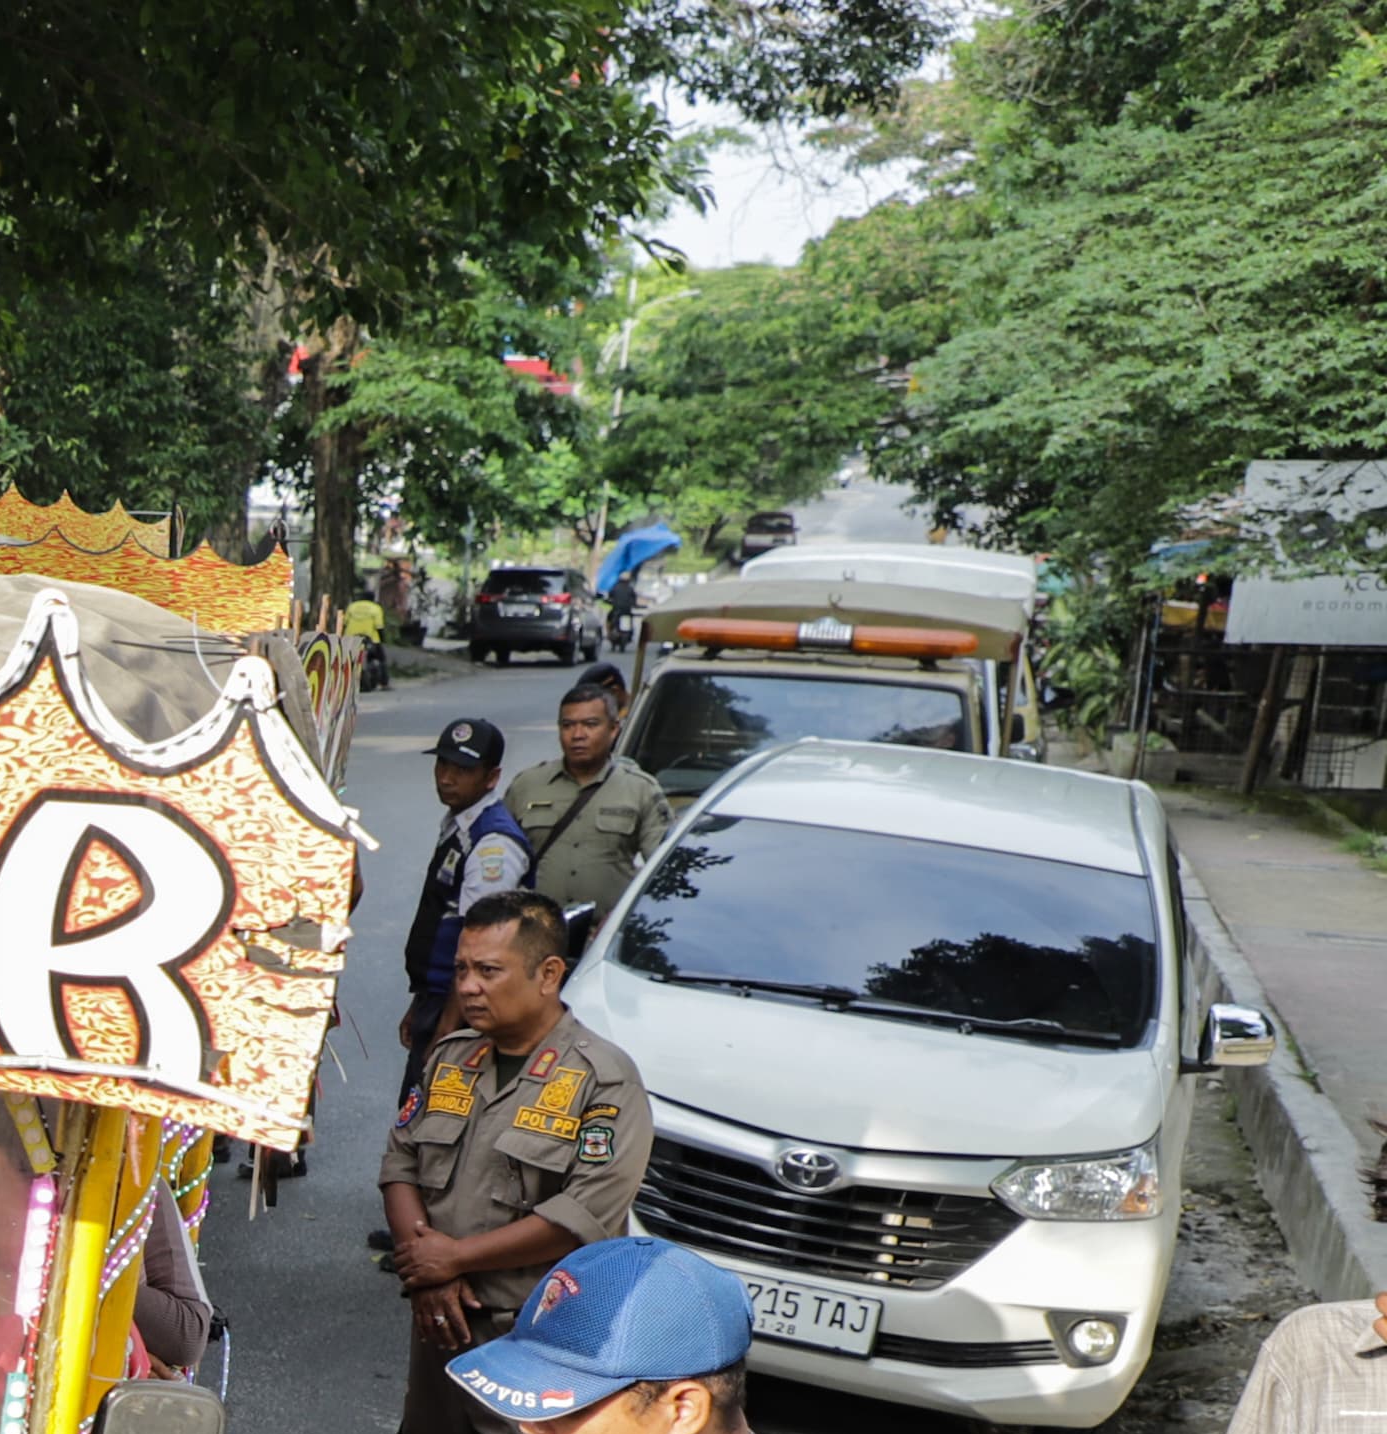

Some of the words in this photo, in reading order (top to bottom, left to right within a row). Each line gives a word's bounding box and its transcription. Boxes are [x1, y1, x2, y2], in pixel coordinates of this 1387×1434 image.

[1302, 600, 1387, 611] econom
[519, 1110, 547, 1130] POL
[551, 1116, 574, 1134] PP
[813, 1296, 869, 1333] TAJ
[462, 1369, 537, 1408] PROVOS
